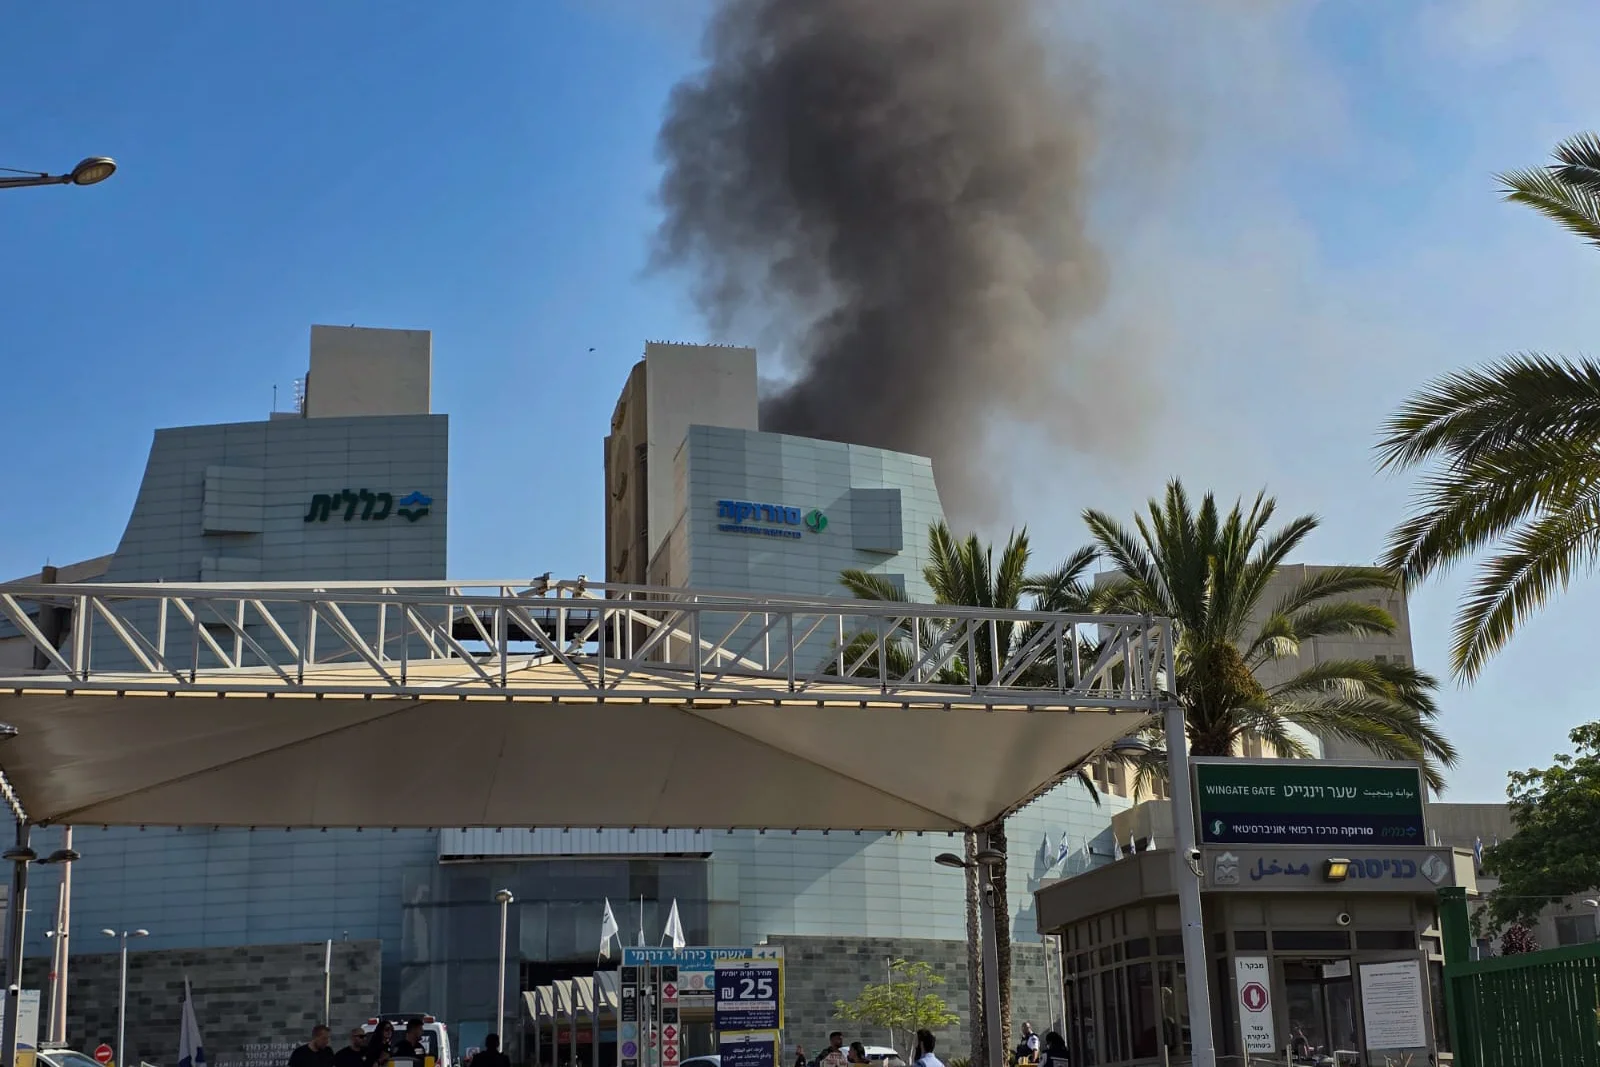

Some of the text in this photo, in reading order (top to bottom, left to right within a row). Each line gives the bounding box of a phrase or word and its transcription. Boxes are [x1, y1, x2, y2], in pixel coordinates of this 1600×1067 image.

[304, 488, 393, 522] כללית
[718, 500, 801, 526] סורוקה
[1206, 785, 1276, 796] WINGATE GATE
[1283, 785, 1357, 798] שער וינגייט
[1232, 824, 1374, 837] סורוקה מרכז רפואי אוניברסיטאי
[1250, 857, 1310, 881] مدخل
[1349, 858, 1417, 879] כניסה
[631, 950, 665, 961] דרומי
[710, 950, 746, 960] אשפוז
[1245, 963, 1264, 971] מבקר
[740, 978, 773, 999] 25
